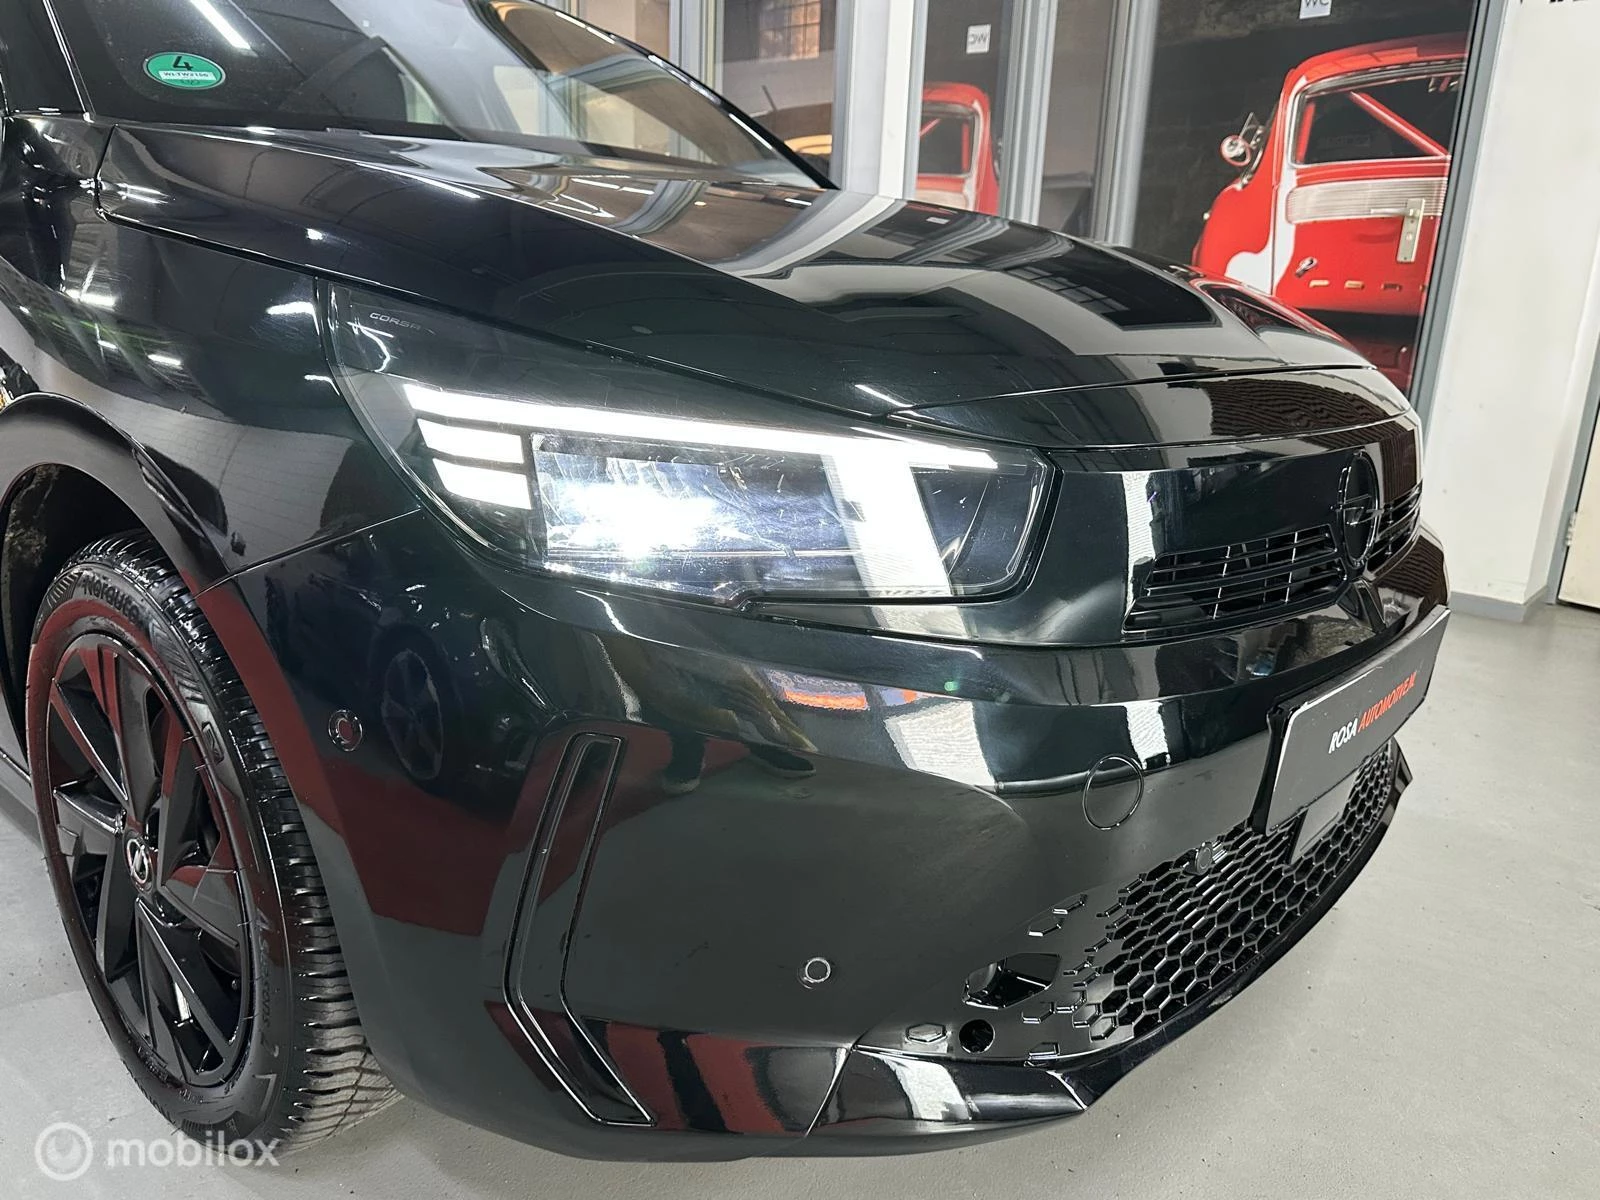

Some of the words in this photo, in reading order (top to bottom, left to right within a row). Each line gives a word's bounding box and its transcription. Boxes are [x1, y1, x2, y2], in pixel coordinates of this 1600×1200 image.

[172, 55, 194, 71] 4
[369, 312, 421, 330] CORSA
[1328, 717, 1358, 754] ROSA
